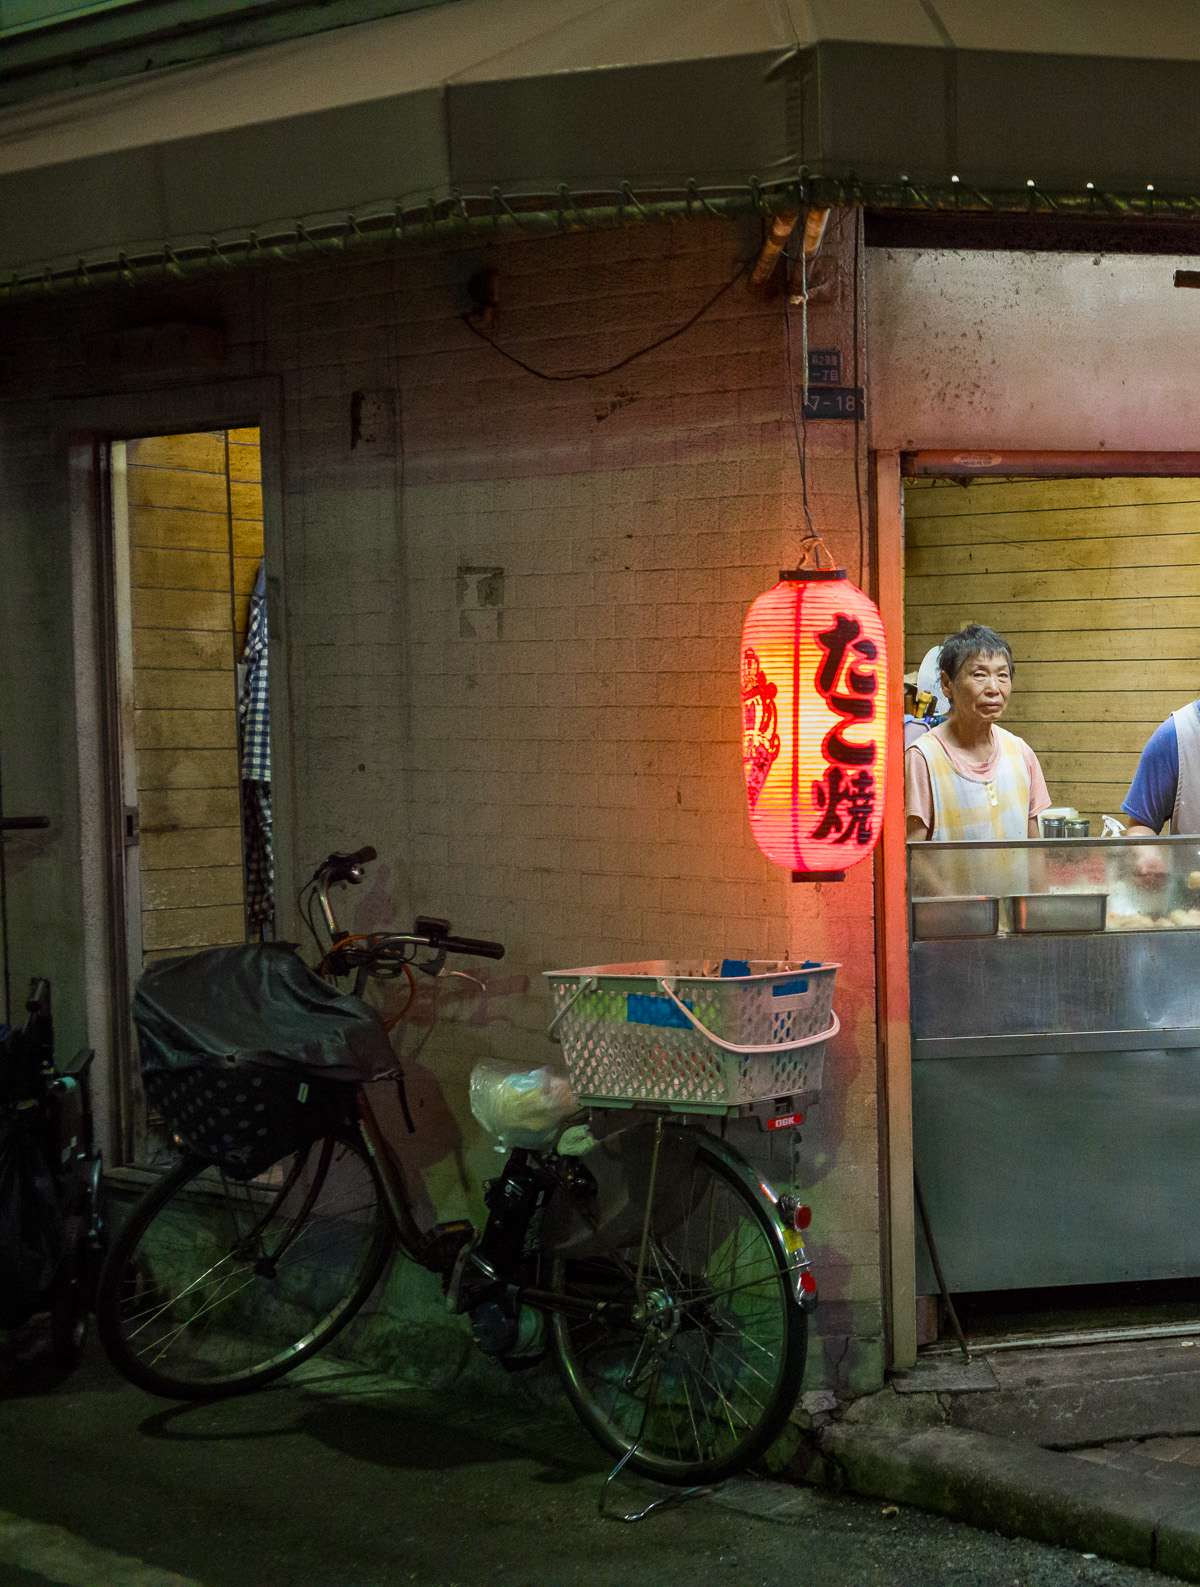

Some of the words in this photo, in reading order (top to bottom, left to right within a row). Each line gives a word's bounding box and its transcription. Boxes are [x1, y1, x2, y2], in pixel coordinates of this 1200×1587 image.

[812, 370, 839, 381] 一丁目
[810, 395, 855, 411] 7-18
[813, 612, 877, 846] たこ焼
